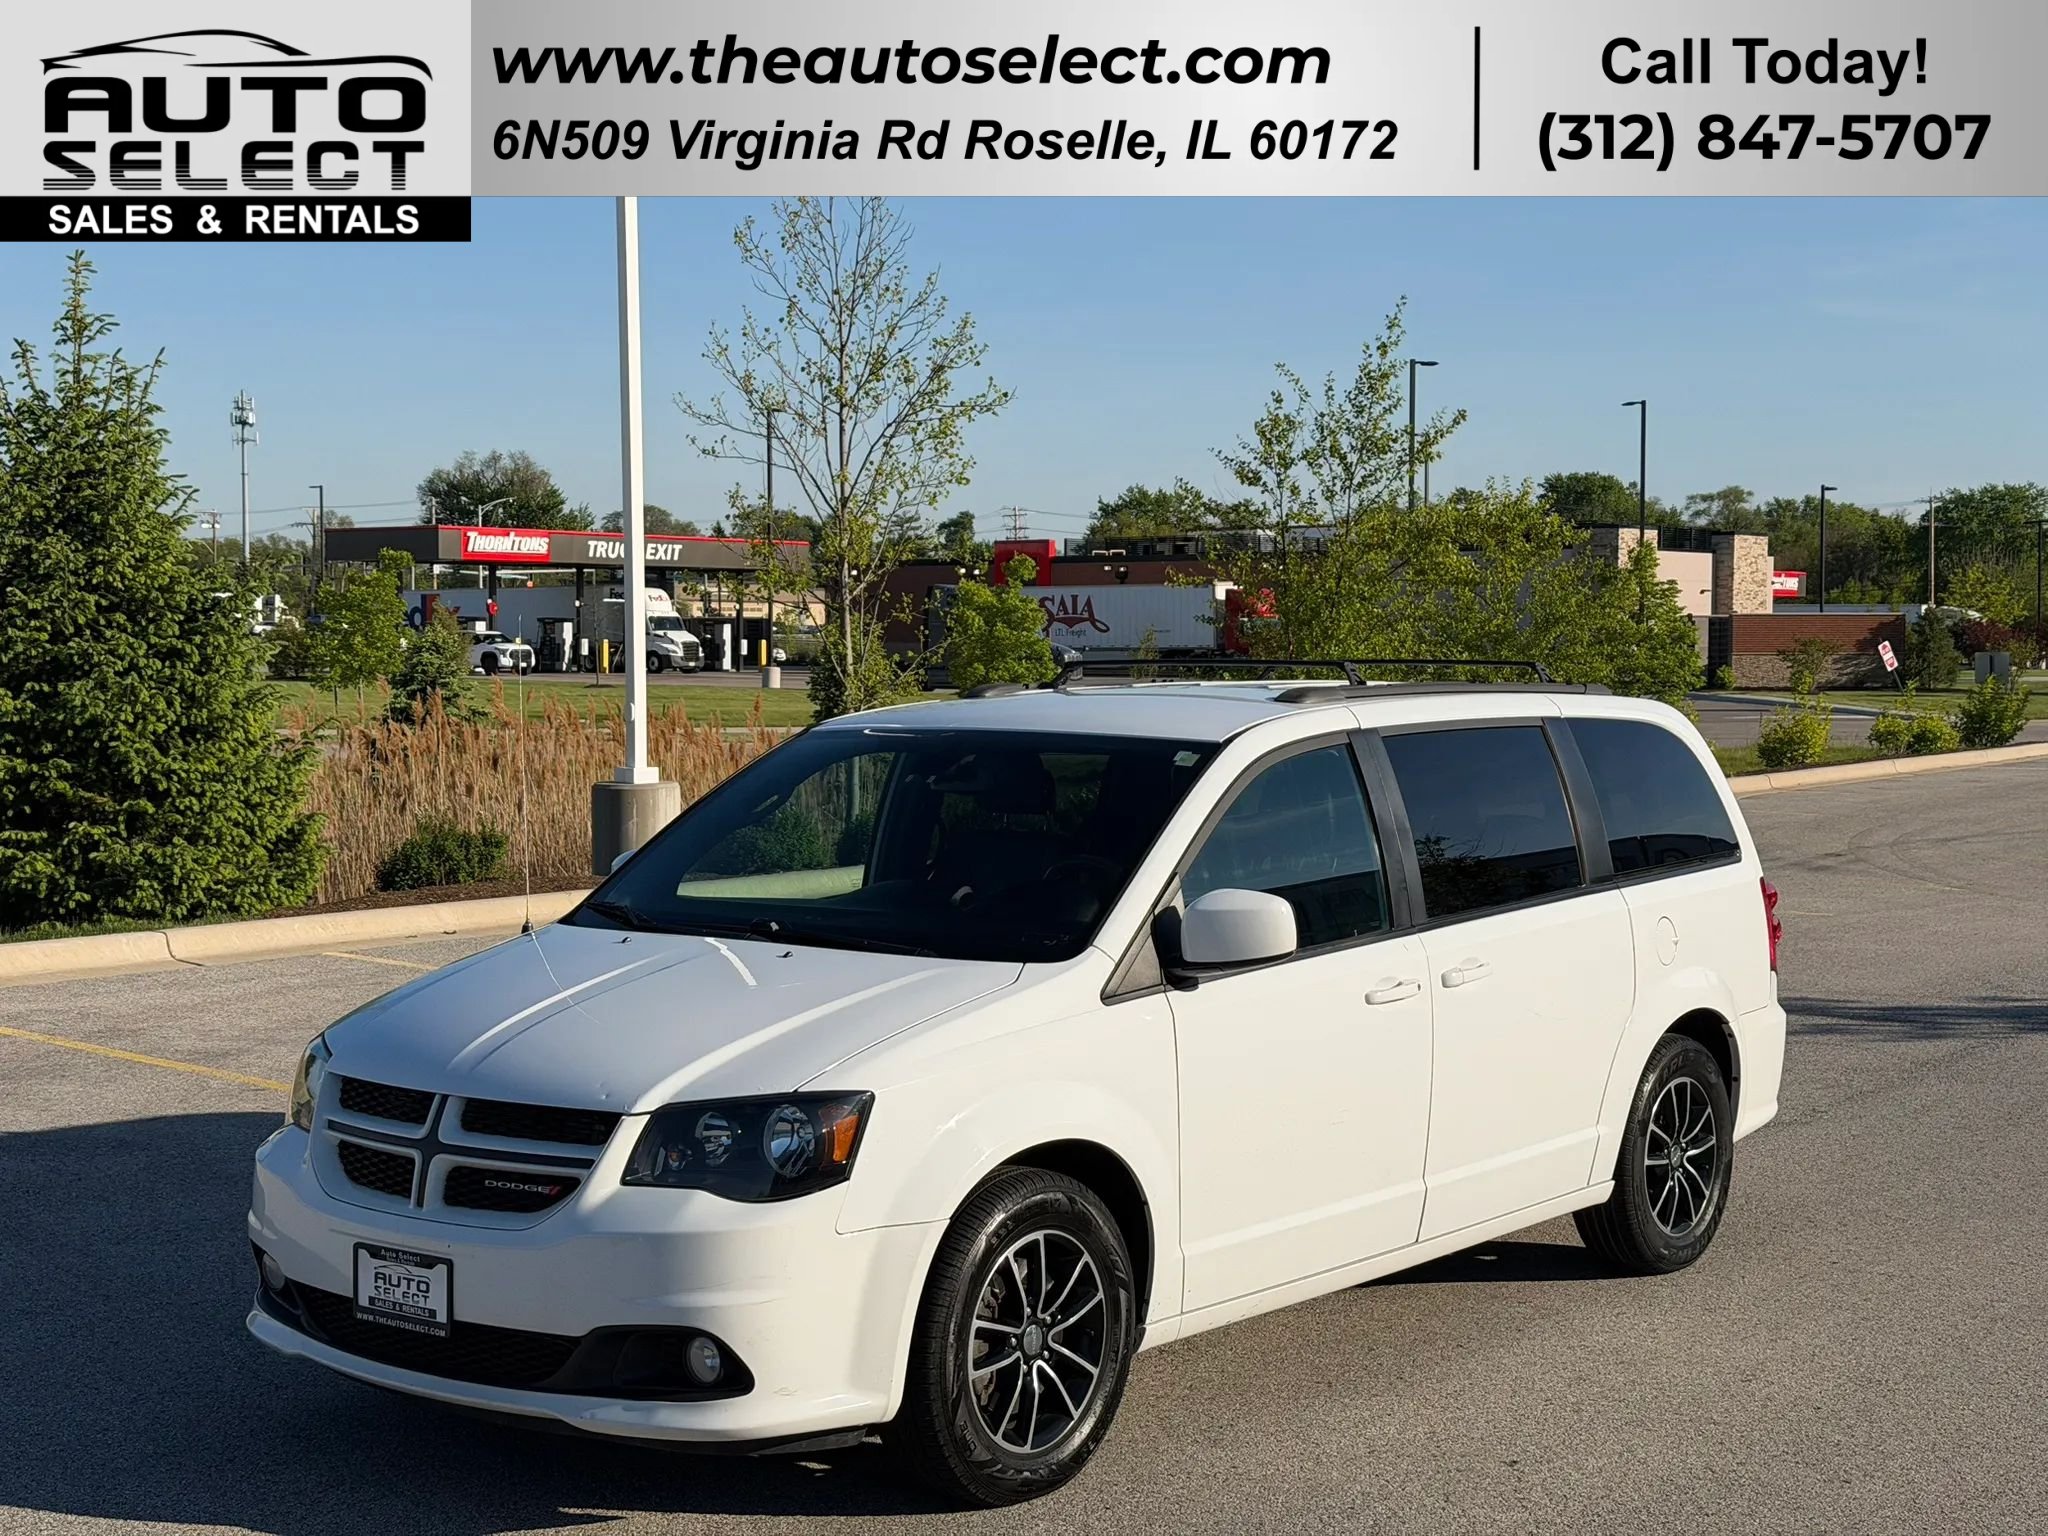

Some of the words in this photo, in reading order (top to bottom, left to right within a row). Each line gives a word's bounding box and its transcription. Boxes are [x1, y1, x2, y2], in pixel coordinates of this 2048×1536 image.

[587, 540, 625, 559] TRU
[646, 543, 682, 561] EXIT
[1038, 593, 1110, 634] SAIA
[484, 1179, 549, 1193] DODGE
[380, 1248, 397, 1258] Auto
[398, 1251, 421, 1262] Select
[374, 1271, 430, 1294] AUTO
[374, 1285, 430, 1306] SELECT
[375, 1299, 393, 1309] SALES
[402, 1305, 430, 1317] RENTALS
[356, 1312, 446, 1337] WWW.THEAUTOSELECT.COM
